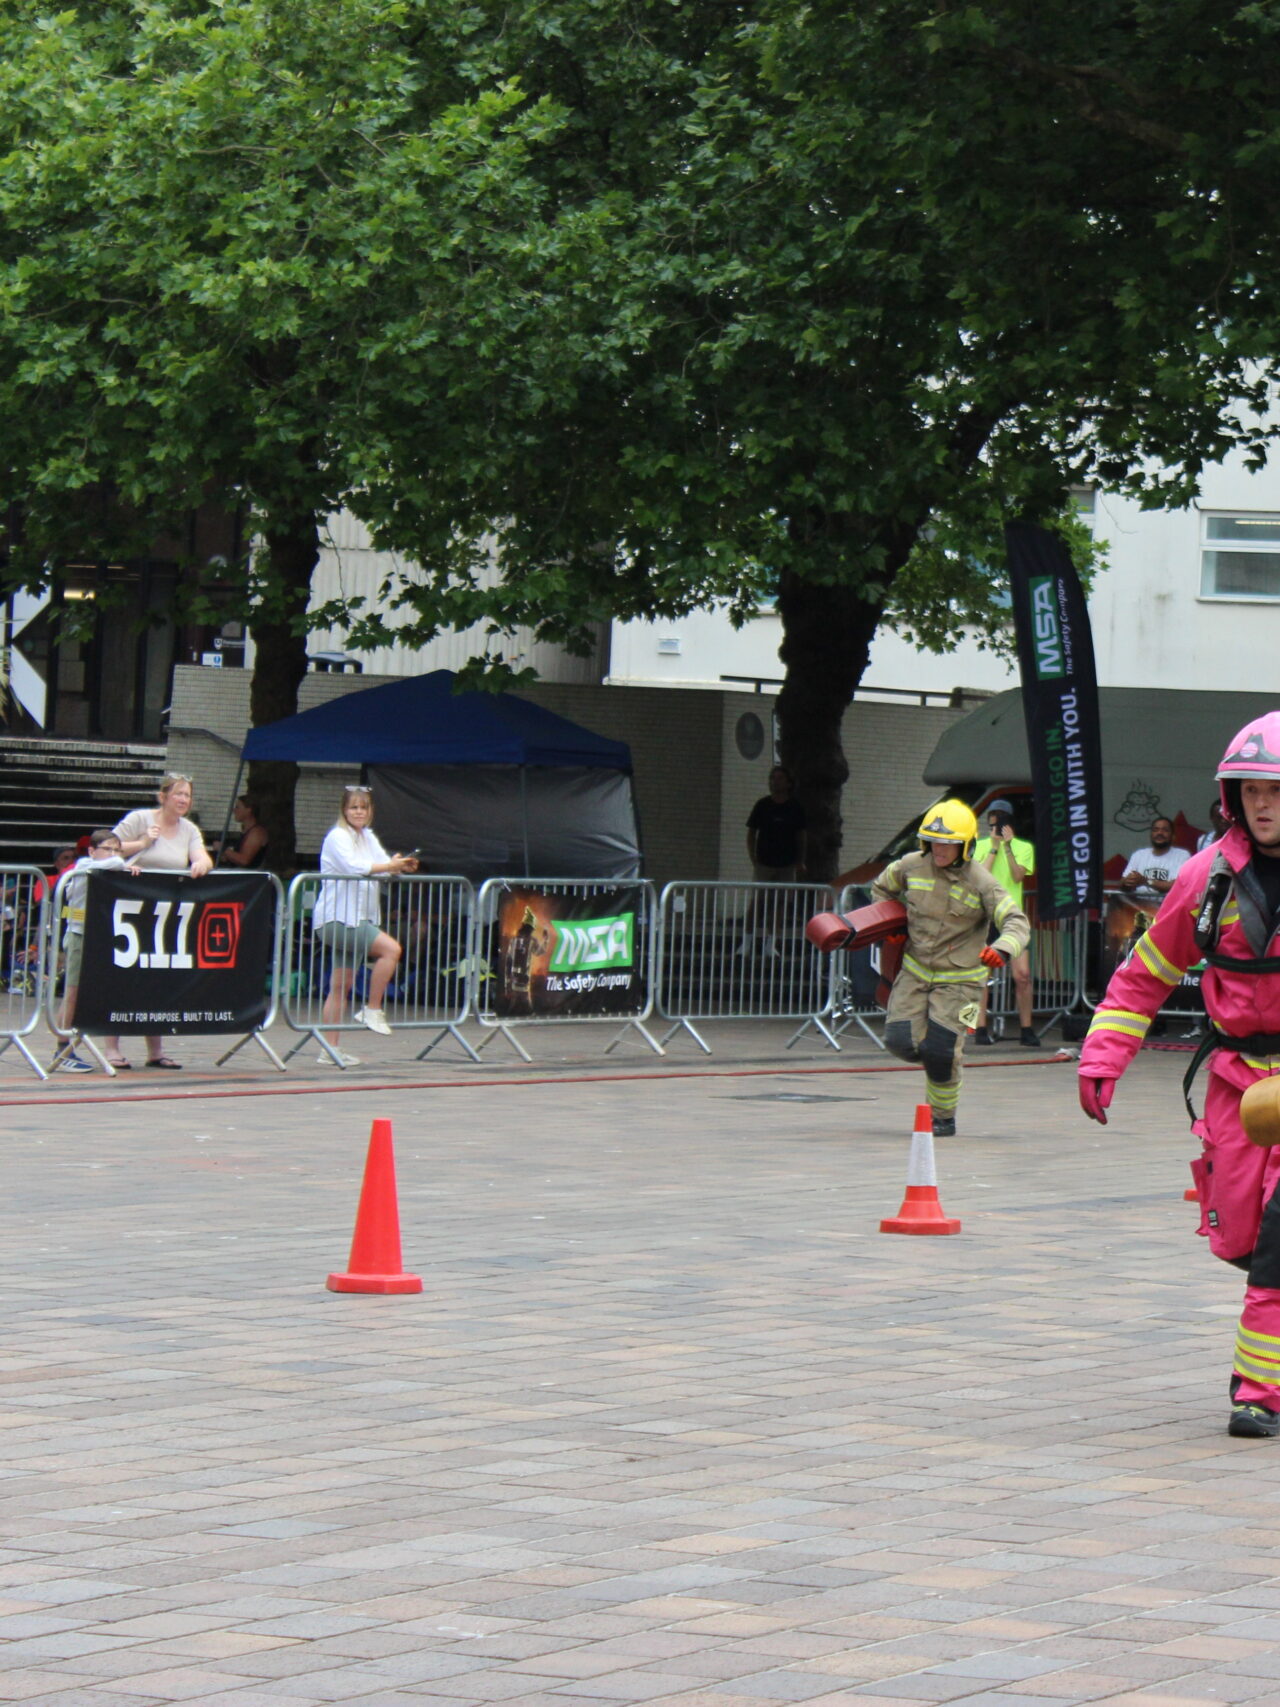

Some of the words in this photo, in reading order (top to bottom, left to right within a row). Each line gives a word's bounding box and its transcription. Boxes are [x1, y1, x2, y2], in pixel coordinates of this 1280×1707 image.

[1033, 580, 1061, 673] MSA
[1061, 625, 1072, 656] Safety
[1065, 657, 1074, 676] The
[1060, 687, 1080, 740] YOU.
[1049, 755, 1065, 788] GO
[1066, 742, 1087, 801] WITH
[1051, 794, 1067, 837] YOU
[1069, 804, 1089, 828] IN
[1072, 831, 1090, 864] GO
[1052, 840, 1073, 908] WHEN
[1144, 868, 1169, 881] NETS
[112, 899, 196, 969] 5.11
[555, 920, 628, 966] MSA
[546, 976, 563, 991] The
[564, 973, 597, 993] Safety
[110, 1012, 134, 1022] BUILT
[135, 1012, 148, 1022] FOR
[149, 1012, 182, 1022] PURPOSE.
[183, 1012, 201, 1022] BUILT
[204, 1012, 213, 1021] TO
[214, 1011, 235, 1021] LAST.
